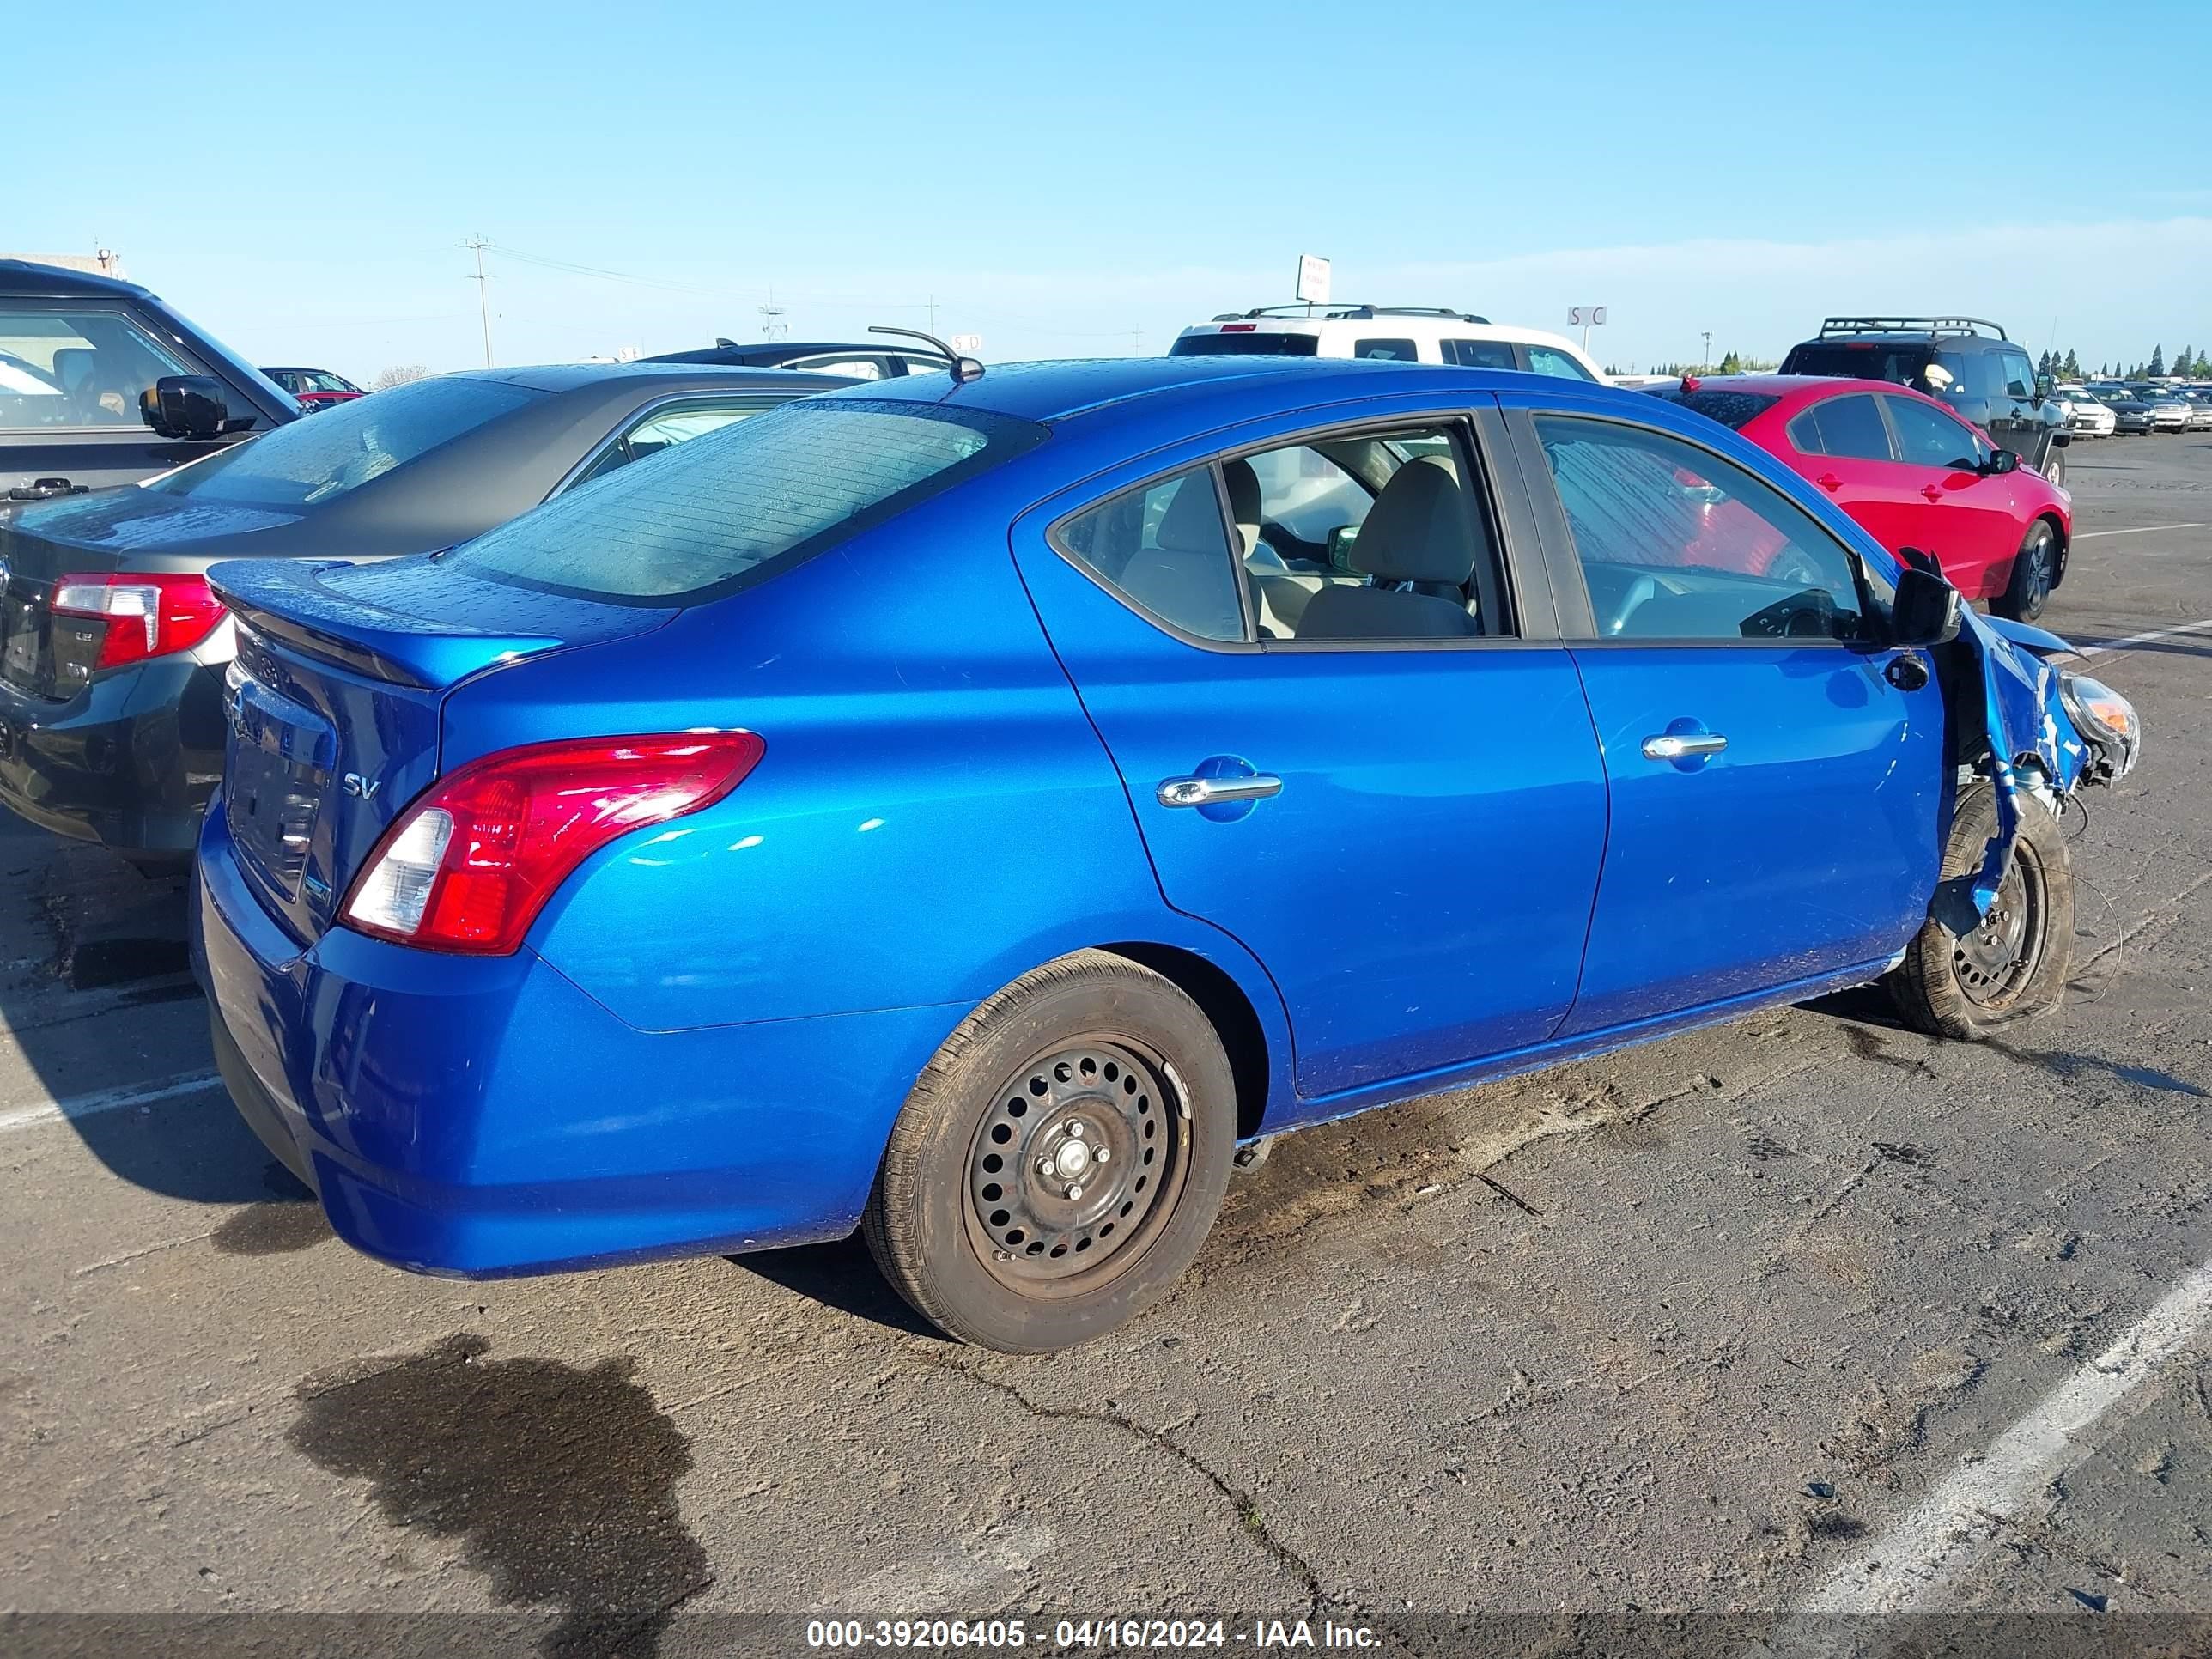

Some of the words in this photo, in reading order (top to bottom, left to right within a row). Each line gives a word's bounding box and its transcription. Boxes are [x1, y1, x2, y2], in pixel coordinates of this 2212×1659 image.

[1571, 307, 1580, 325] S
[1593, 307, 1604, 325] C
[955, 336, 962, 350] S
[969, 336, 979, 349] D
[75, 631, 93, 641] LE
[343, 772, 382, 799] SV
